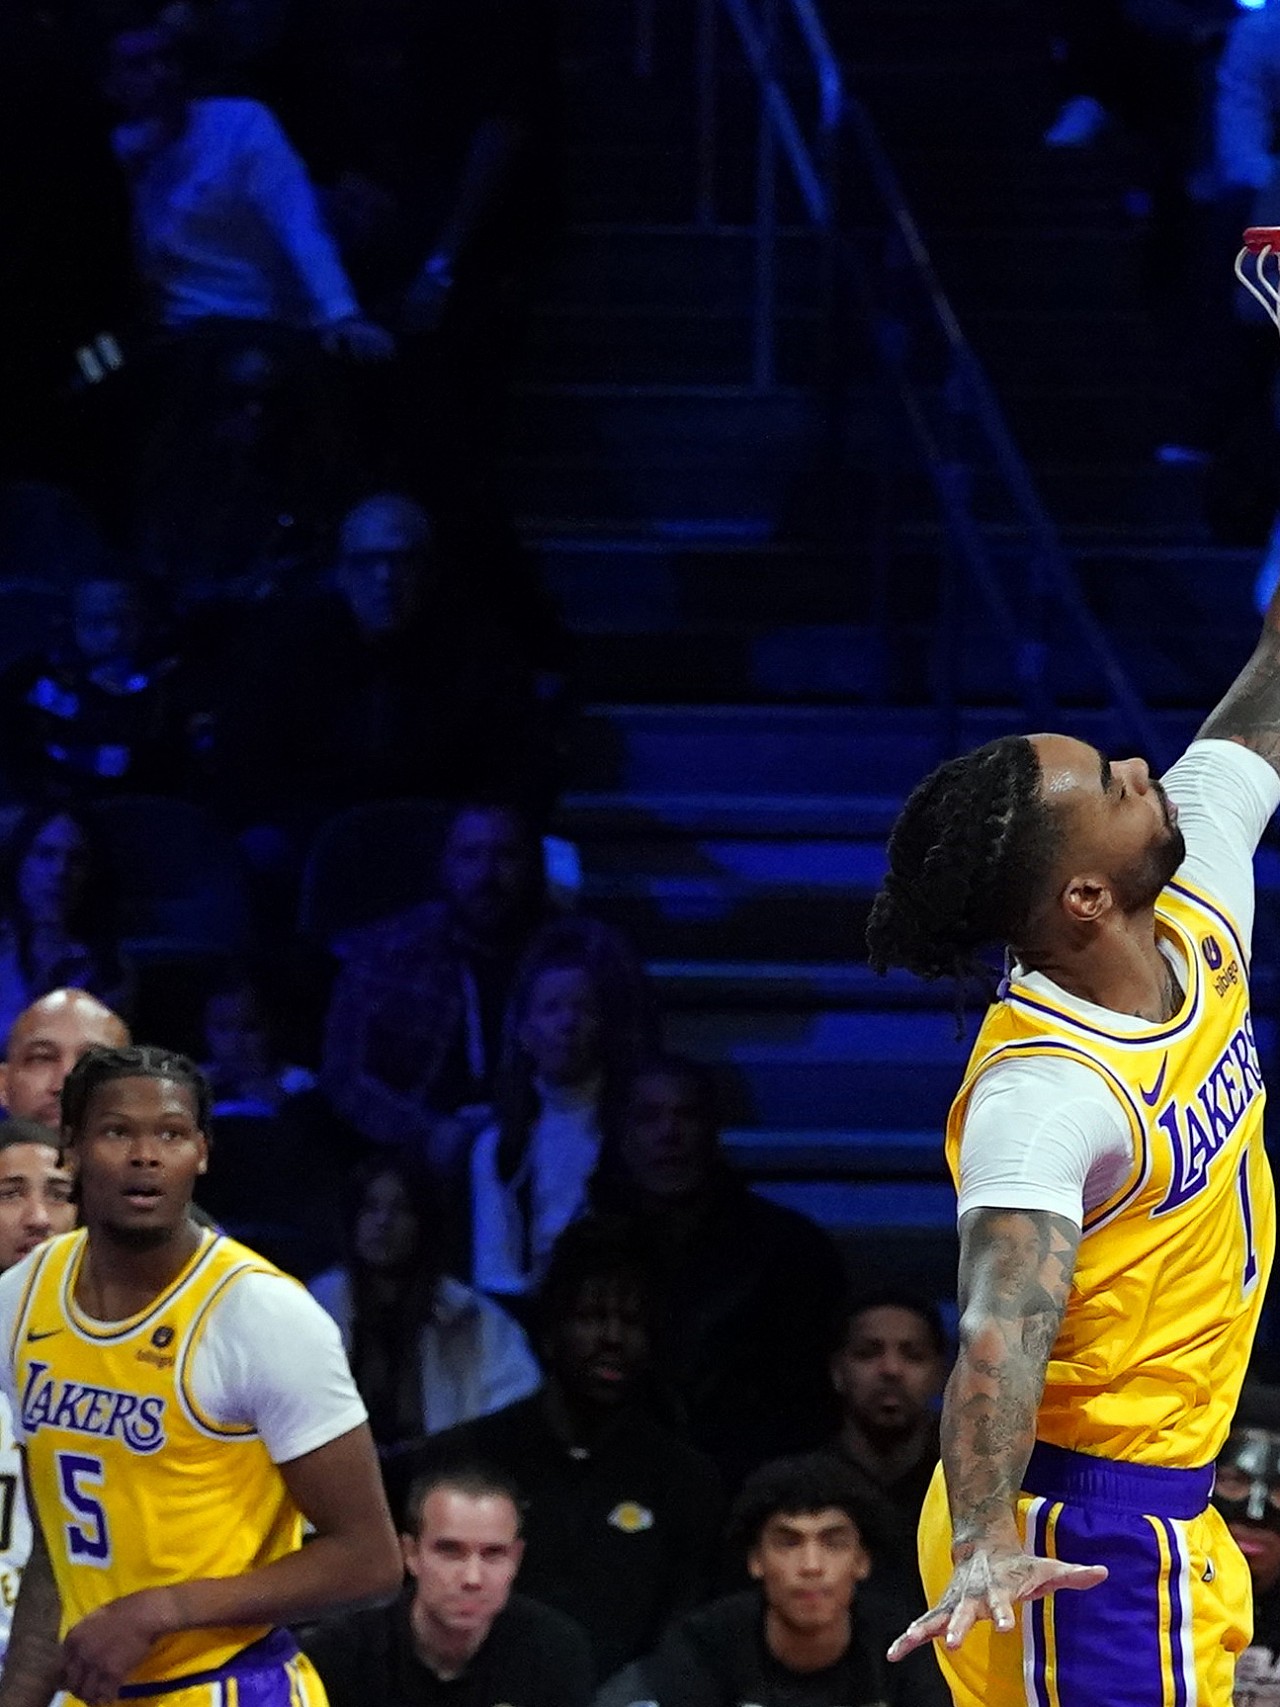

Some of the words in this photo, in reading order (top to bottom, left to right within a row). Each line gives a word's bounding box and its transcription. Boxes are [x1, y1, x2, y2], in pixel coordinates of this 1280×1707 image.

[1213, 960, 1239, 998] bibigo
[1237, 1146, 1258, 1294] 1
[21, 1361, 166, 1454] LAKERS
[58, 1452, 110, 1565] 5
